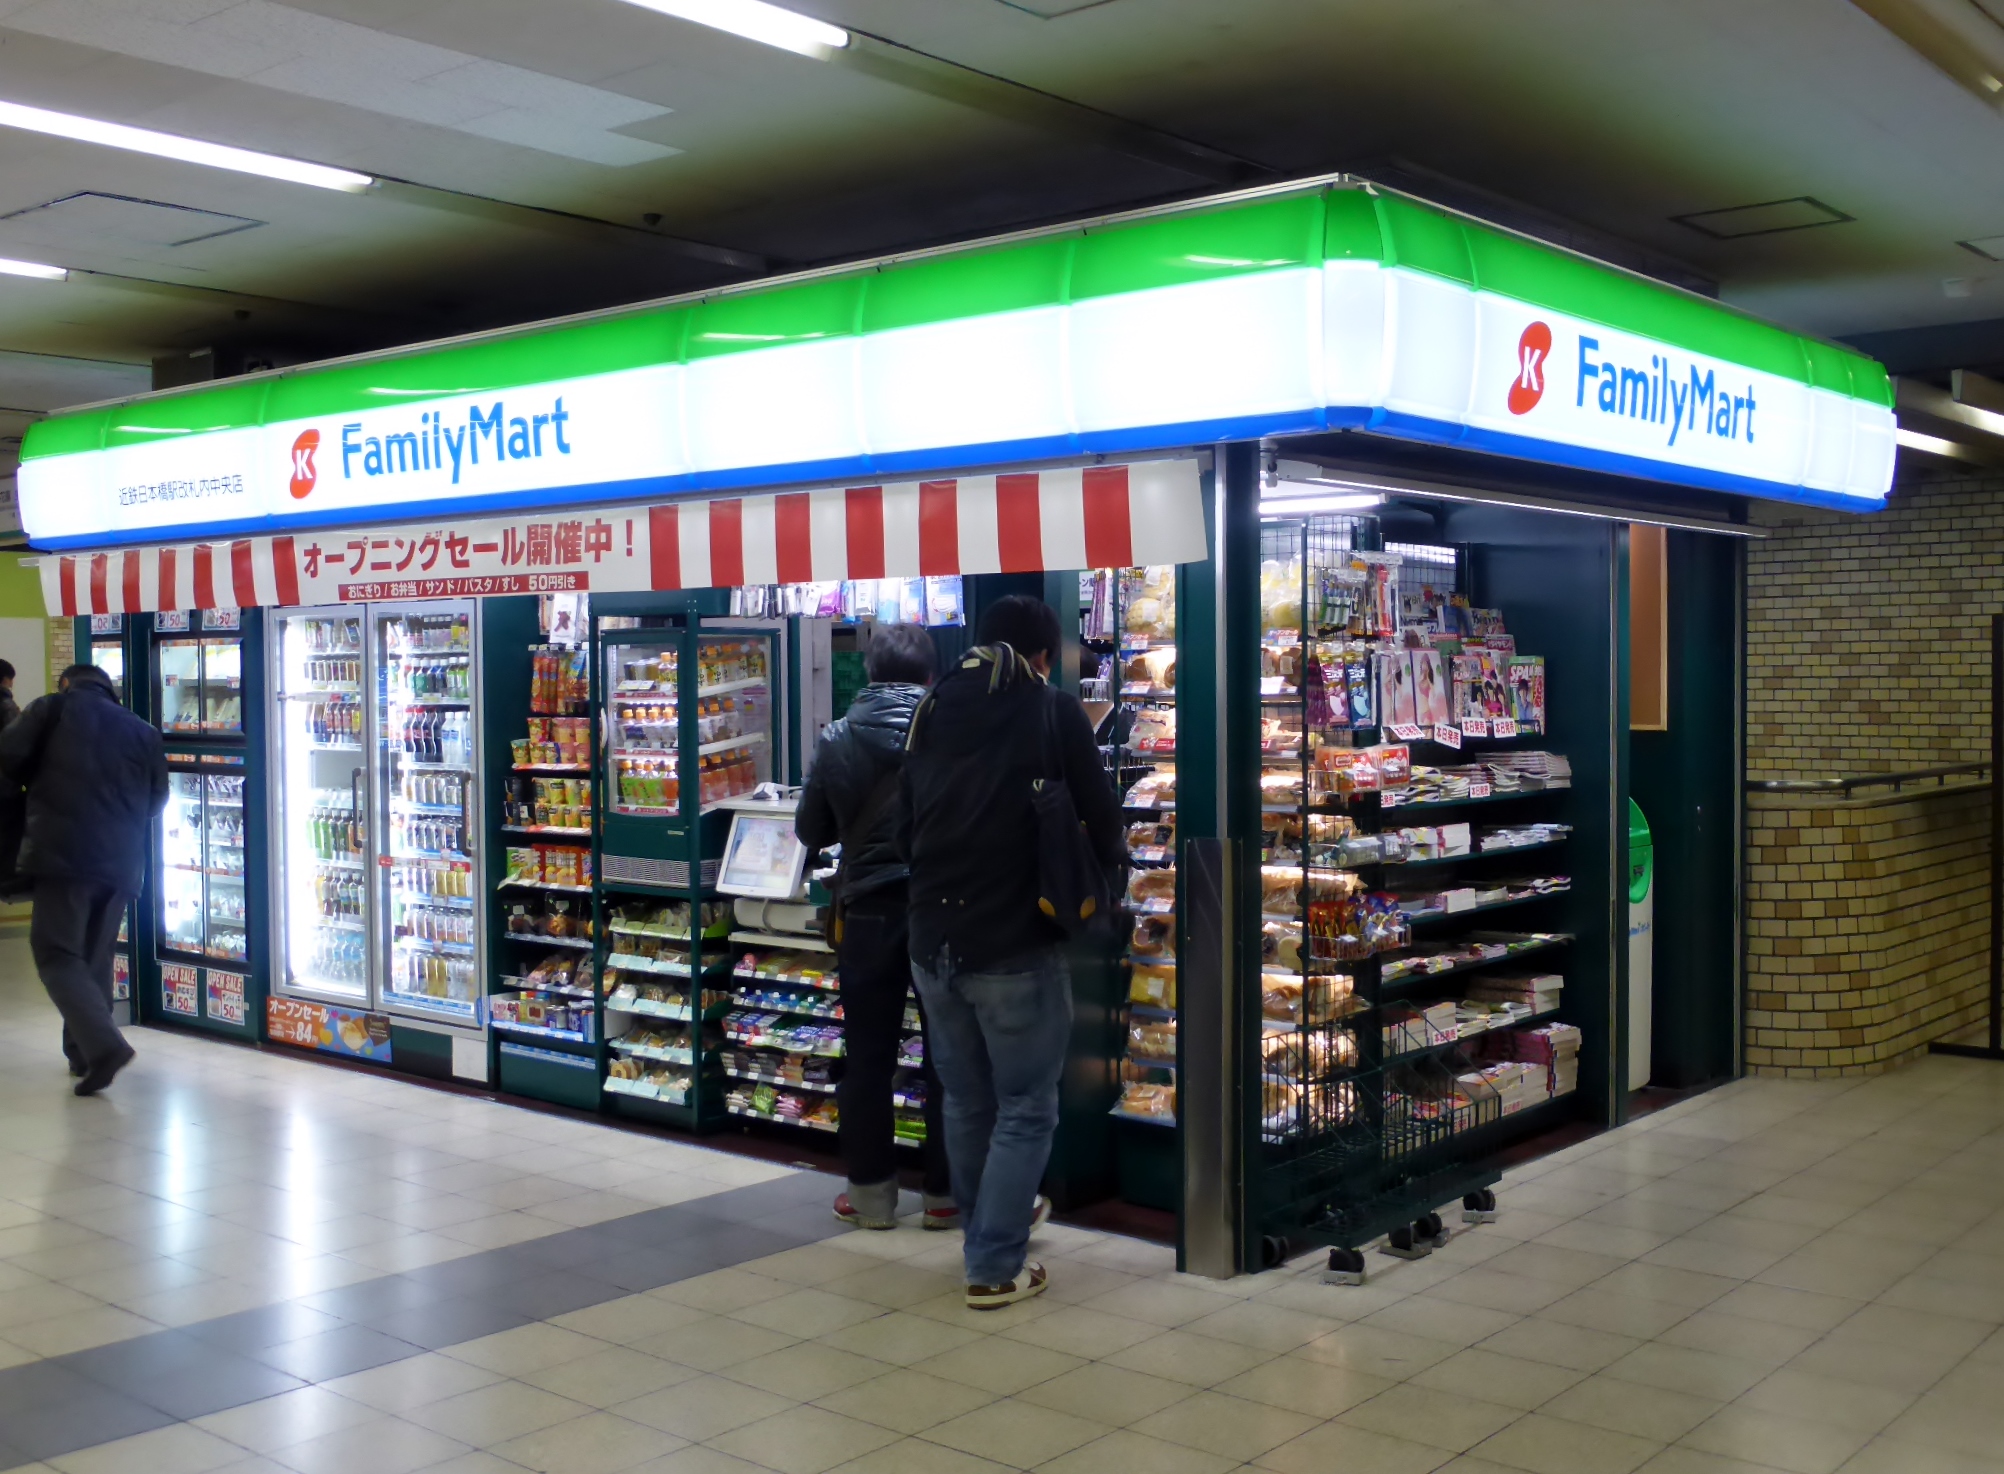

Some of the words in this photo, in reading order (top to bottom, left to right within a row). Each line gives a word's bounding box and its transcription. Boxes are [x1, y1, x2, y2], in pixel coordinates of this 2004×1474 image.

[1521, 346, 1541, 391] K
[1576, 334, 1757, 446] FamilyMart
[341, 395, 571, 485] FamilyMart
[295, 448, 313, 480] K
[119, 474, 243, 506] 近鉄日本橋駅改札内中央店
[528, 574, 576, 590] 50円引き
[1436, 726, 1460, 746] 本日発売
[1463, 720, 1486, 734] 本日発売
[1495, 721, 1516, 735] 本日発売
[1471, 784, 1491, 798] 本日発売
[163, 965, 179, 982] OPEN
[180, 967, 196, 985] SALE
[208, 970, 225, 989] OPEN
[225, 975, 243, 993] SALE
[269, 1000, 329, 1024] オープンセール
